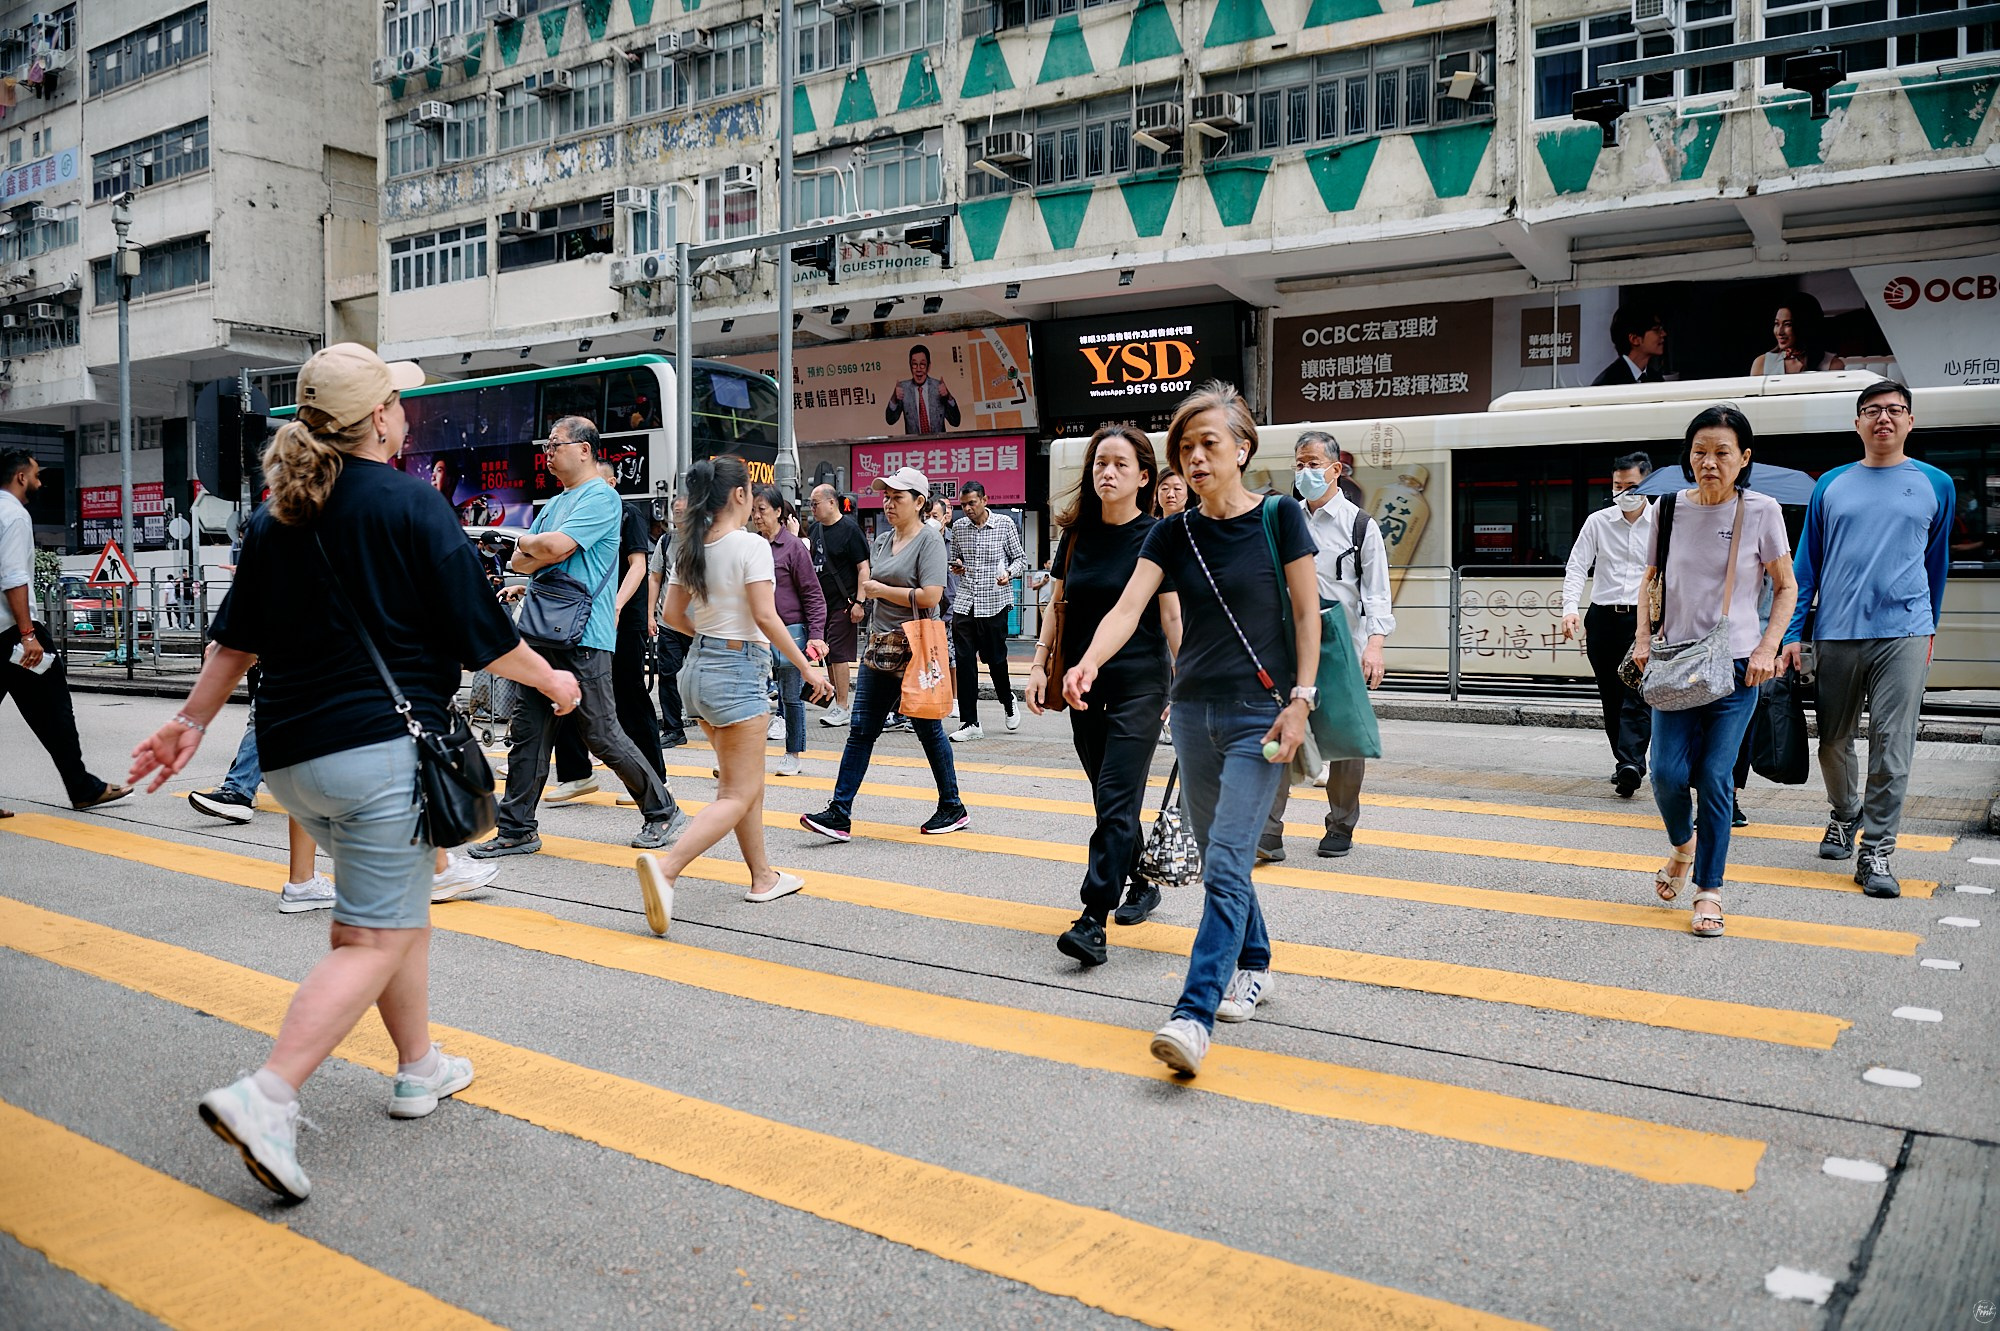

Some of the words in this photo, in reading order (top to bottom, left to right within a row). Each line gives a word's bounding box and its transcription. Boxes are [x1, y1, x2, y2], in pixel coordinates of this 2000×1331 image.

[1924, 274, 2000, 303] OCB
[807, 365, 824, 378] 預約
[837, 363, 858, 374] 5969
[861, 361, 882, 373] 1218
[1079, 340, 1196, 385] YSD
[1301, 353, 1393, 379] 讓時間增值
[1090, 389, 1126, 397] WhatsApp:
[1126, 383, 1157, 395] 9679
[1161, 380, 1192, 393] 6007
[1301, 371, 1469, 402] 令財富潛力發揮極致
